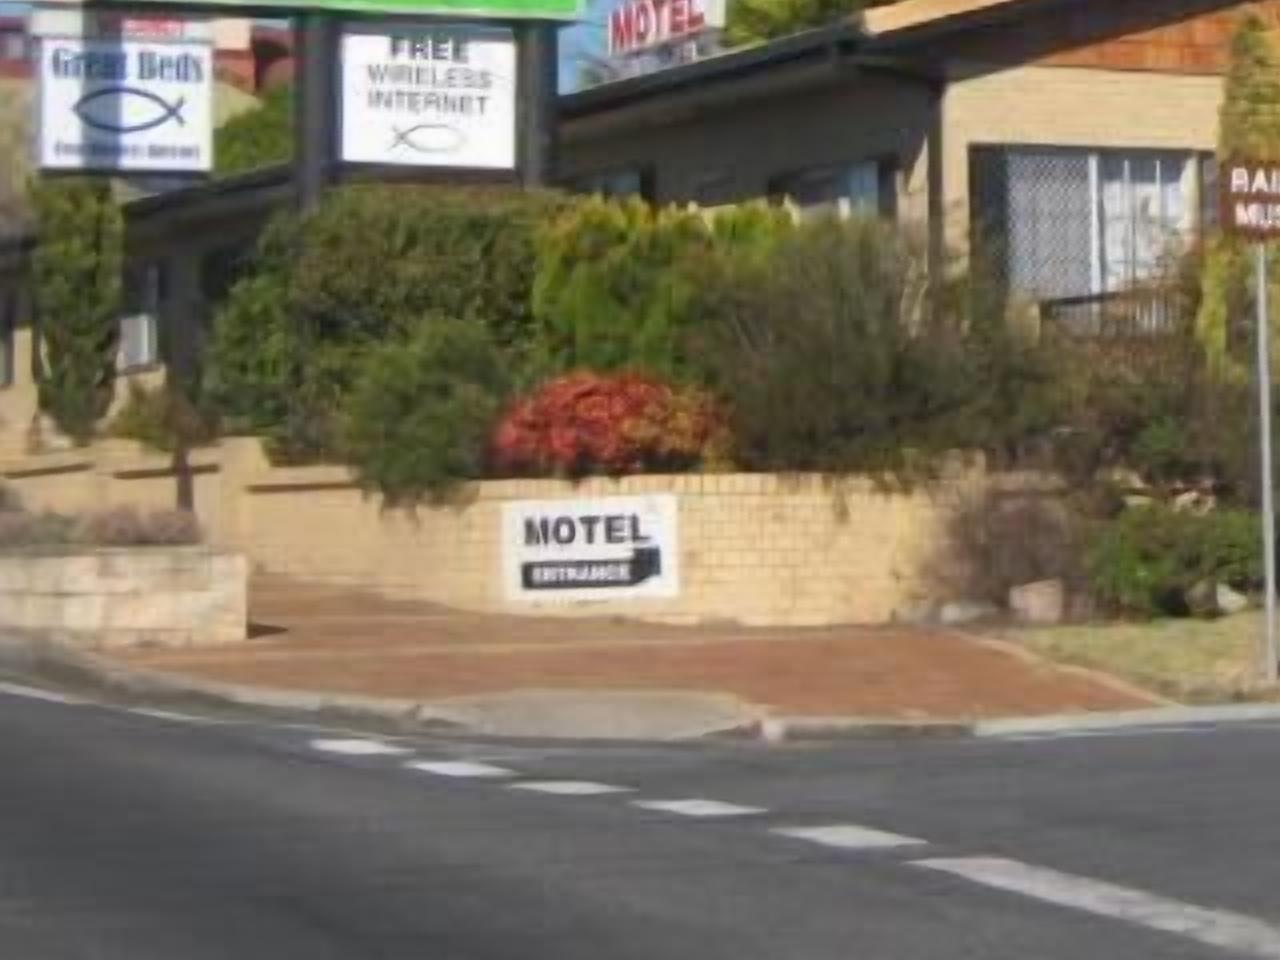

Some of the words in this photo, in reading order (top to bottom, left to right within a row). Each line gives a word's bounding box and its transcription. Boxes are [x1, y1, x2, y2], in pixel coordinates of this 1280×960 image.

[389, 36, 469, 63] FREE
[367, 63, 493, 89] WIRELESS
[524, 513, 652, 546] MOTEL
